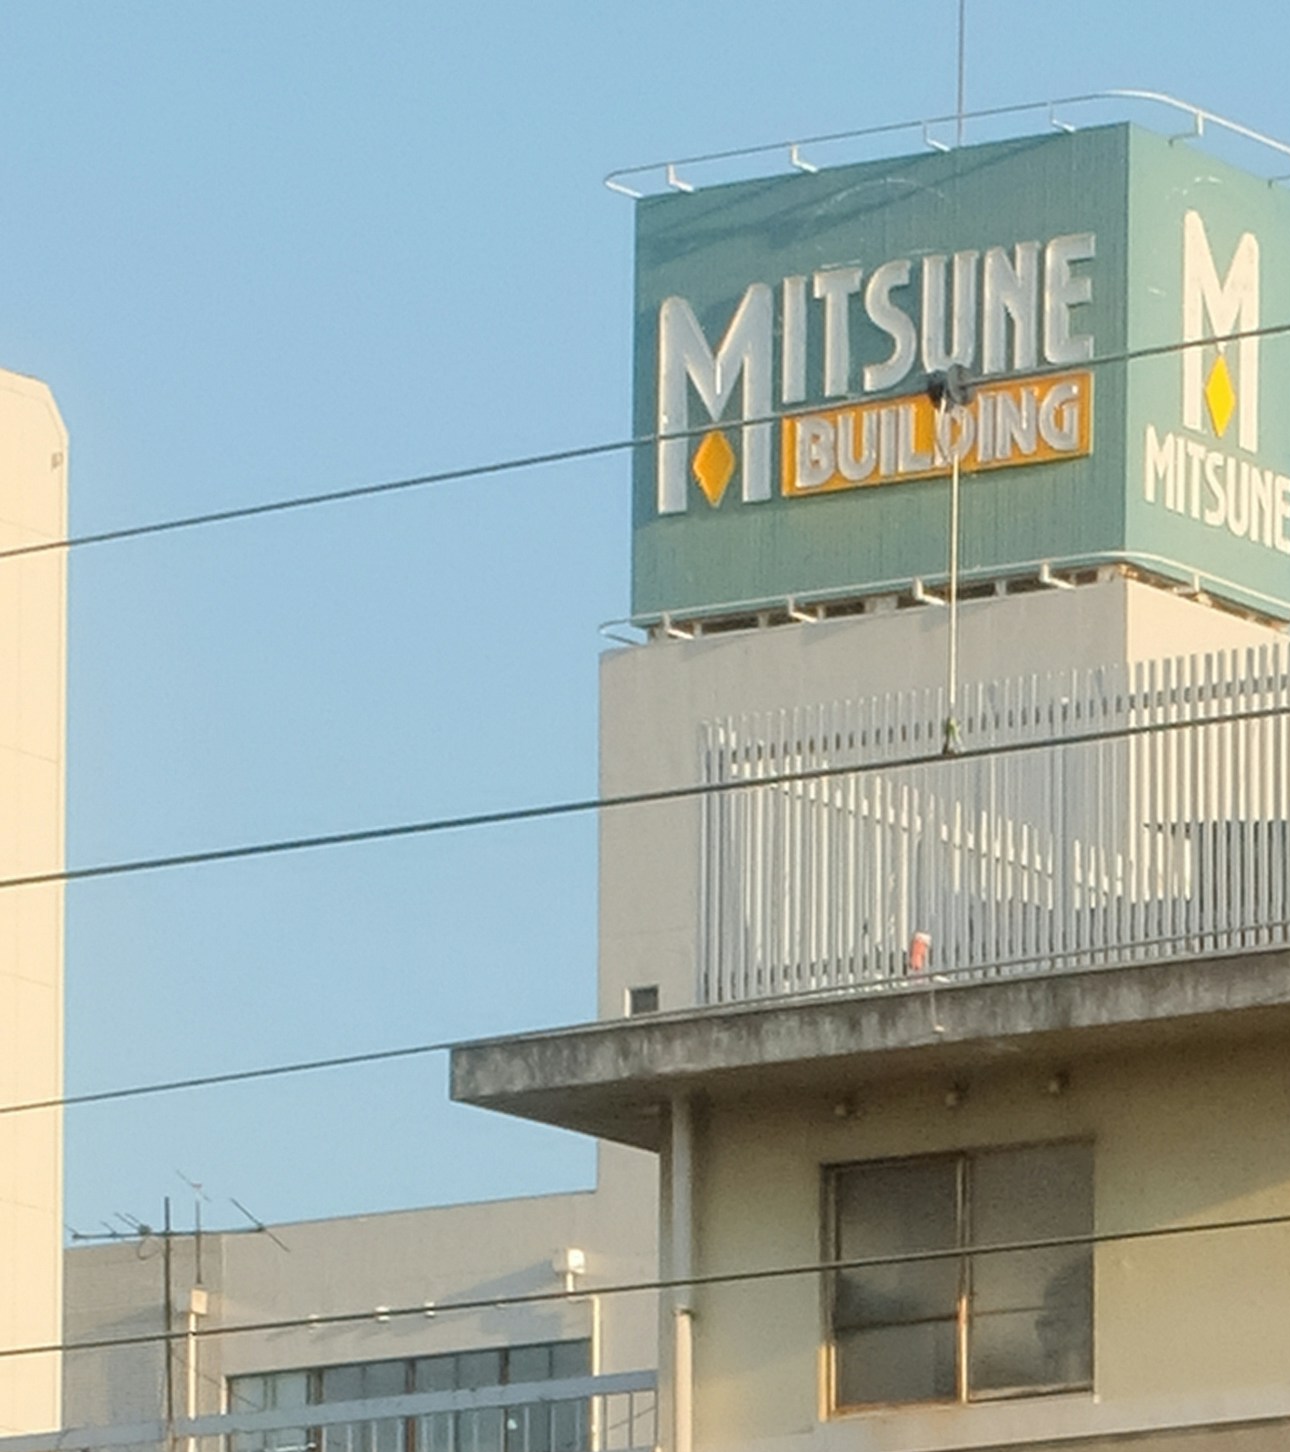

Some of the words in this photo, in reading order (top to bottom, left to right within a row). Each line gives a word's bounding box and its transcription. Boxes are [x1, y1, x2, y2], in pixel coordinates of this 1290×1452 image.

[657, 233, 1095, 515] MITSUNE
[795, 381, 1080, 488] BUILDING
[1182, 210, 1259, 453] M
